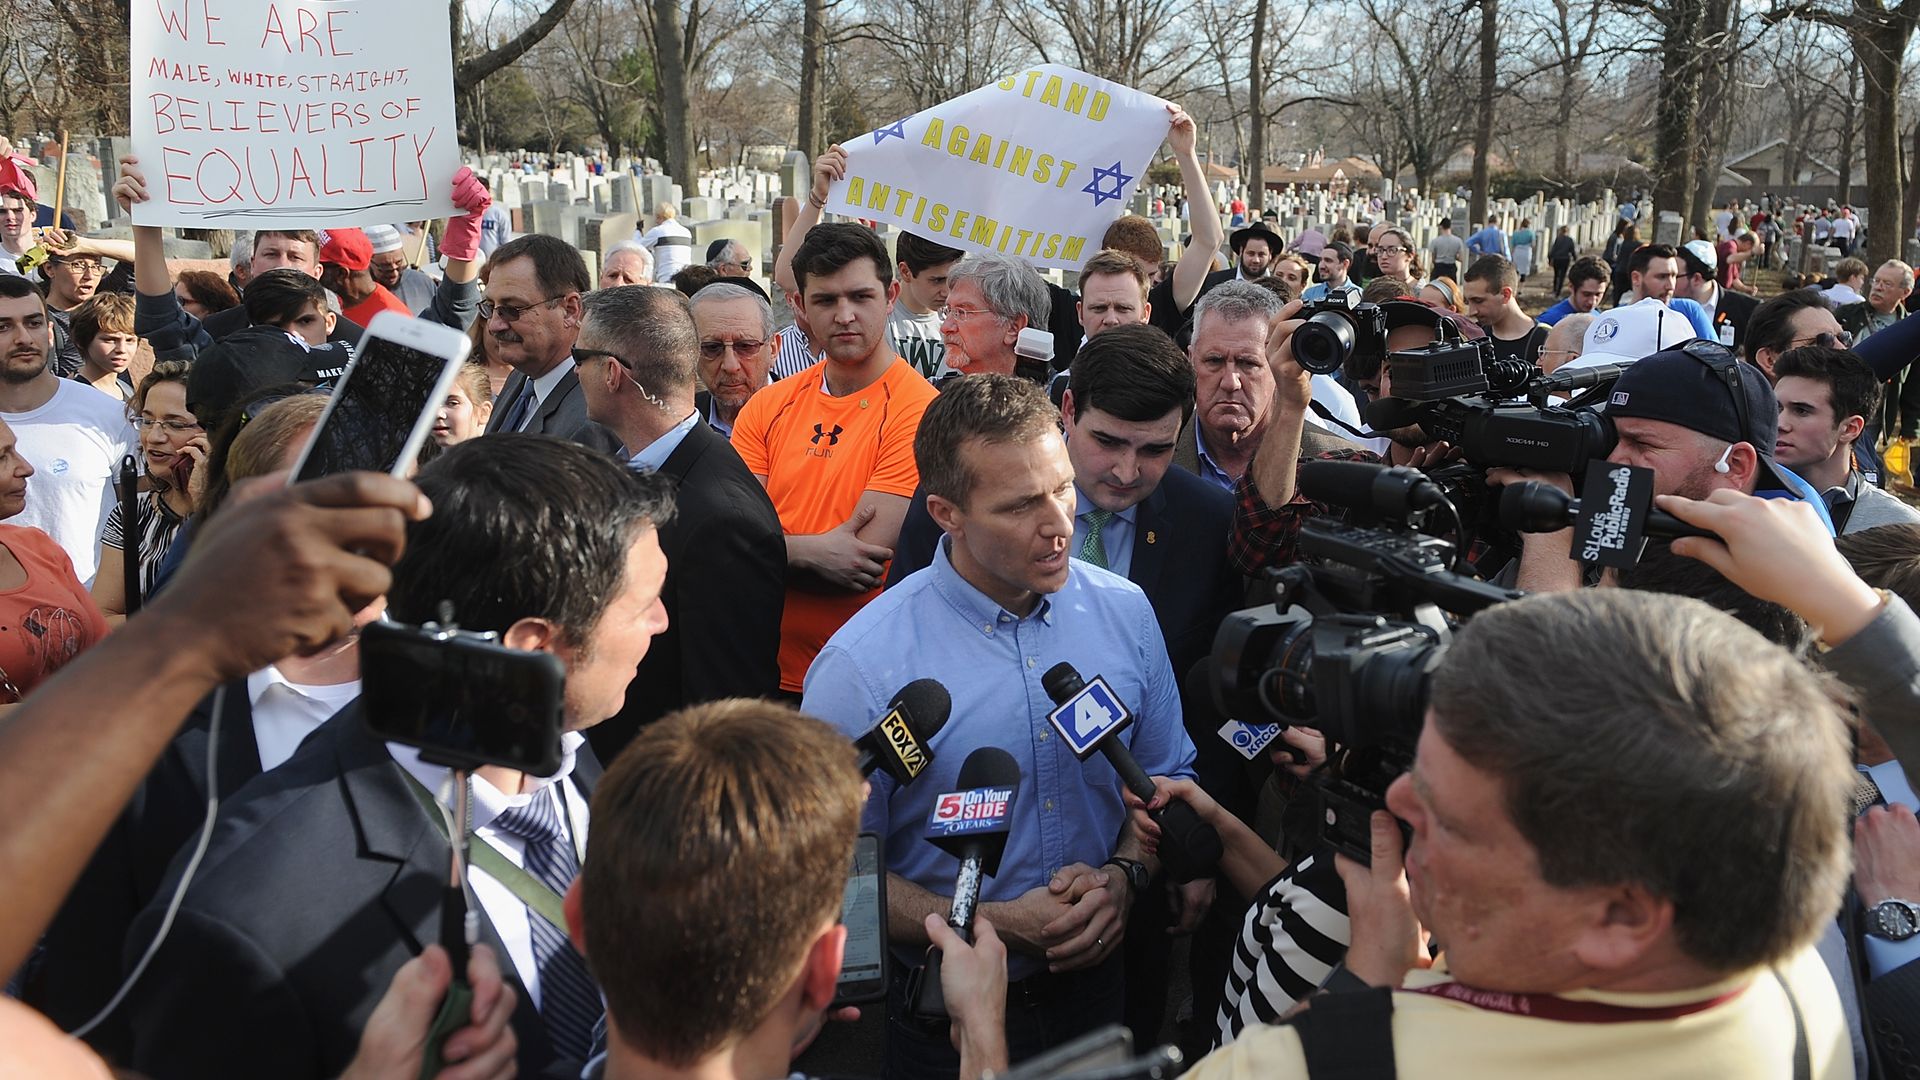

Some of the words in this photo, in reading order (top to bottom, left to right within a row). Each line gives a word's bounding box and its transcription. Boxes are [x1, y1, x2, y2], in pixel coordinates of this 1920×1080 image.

[156, 0, 226, 45] WE
[148, 57, 221, 88] MALE,
[227, 69, 293, 89] WHITE,
[297, 68, 409, 93] STRAIGHT,
[997, 70, 1112, 122] STAND
[149, 92, 370, 134] BELIEVERS
[381, 98, 421, 119] OF
[162, 126, 435, 206] EQUALITY
[921, 117, 1078, 189] AGAINST
[845, 176, 1087, 262] ANTISEMITISM
[316, 367, 345, 378] MAKE
[1074, 692, 1113, 739] 4
[1247, 724, 1279, 755] KRCG
[937, 796, 961, 818] 5
[964, 802, 1006, 819] SIDE
